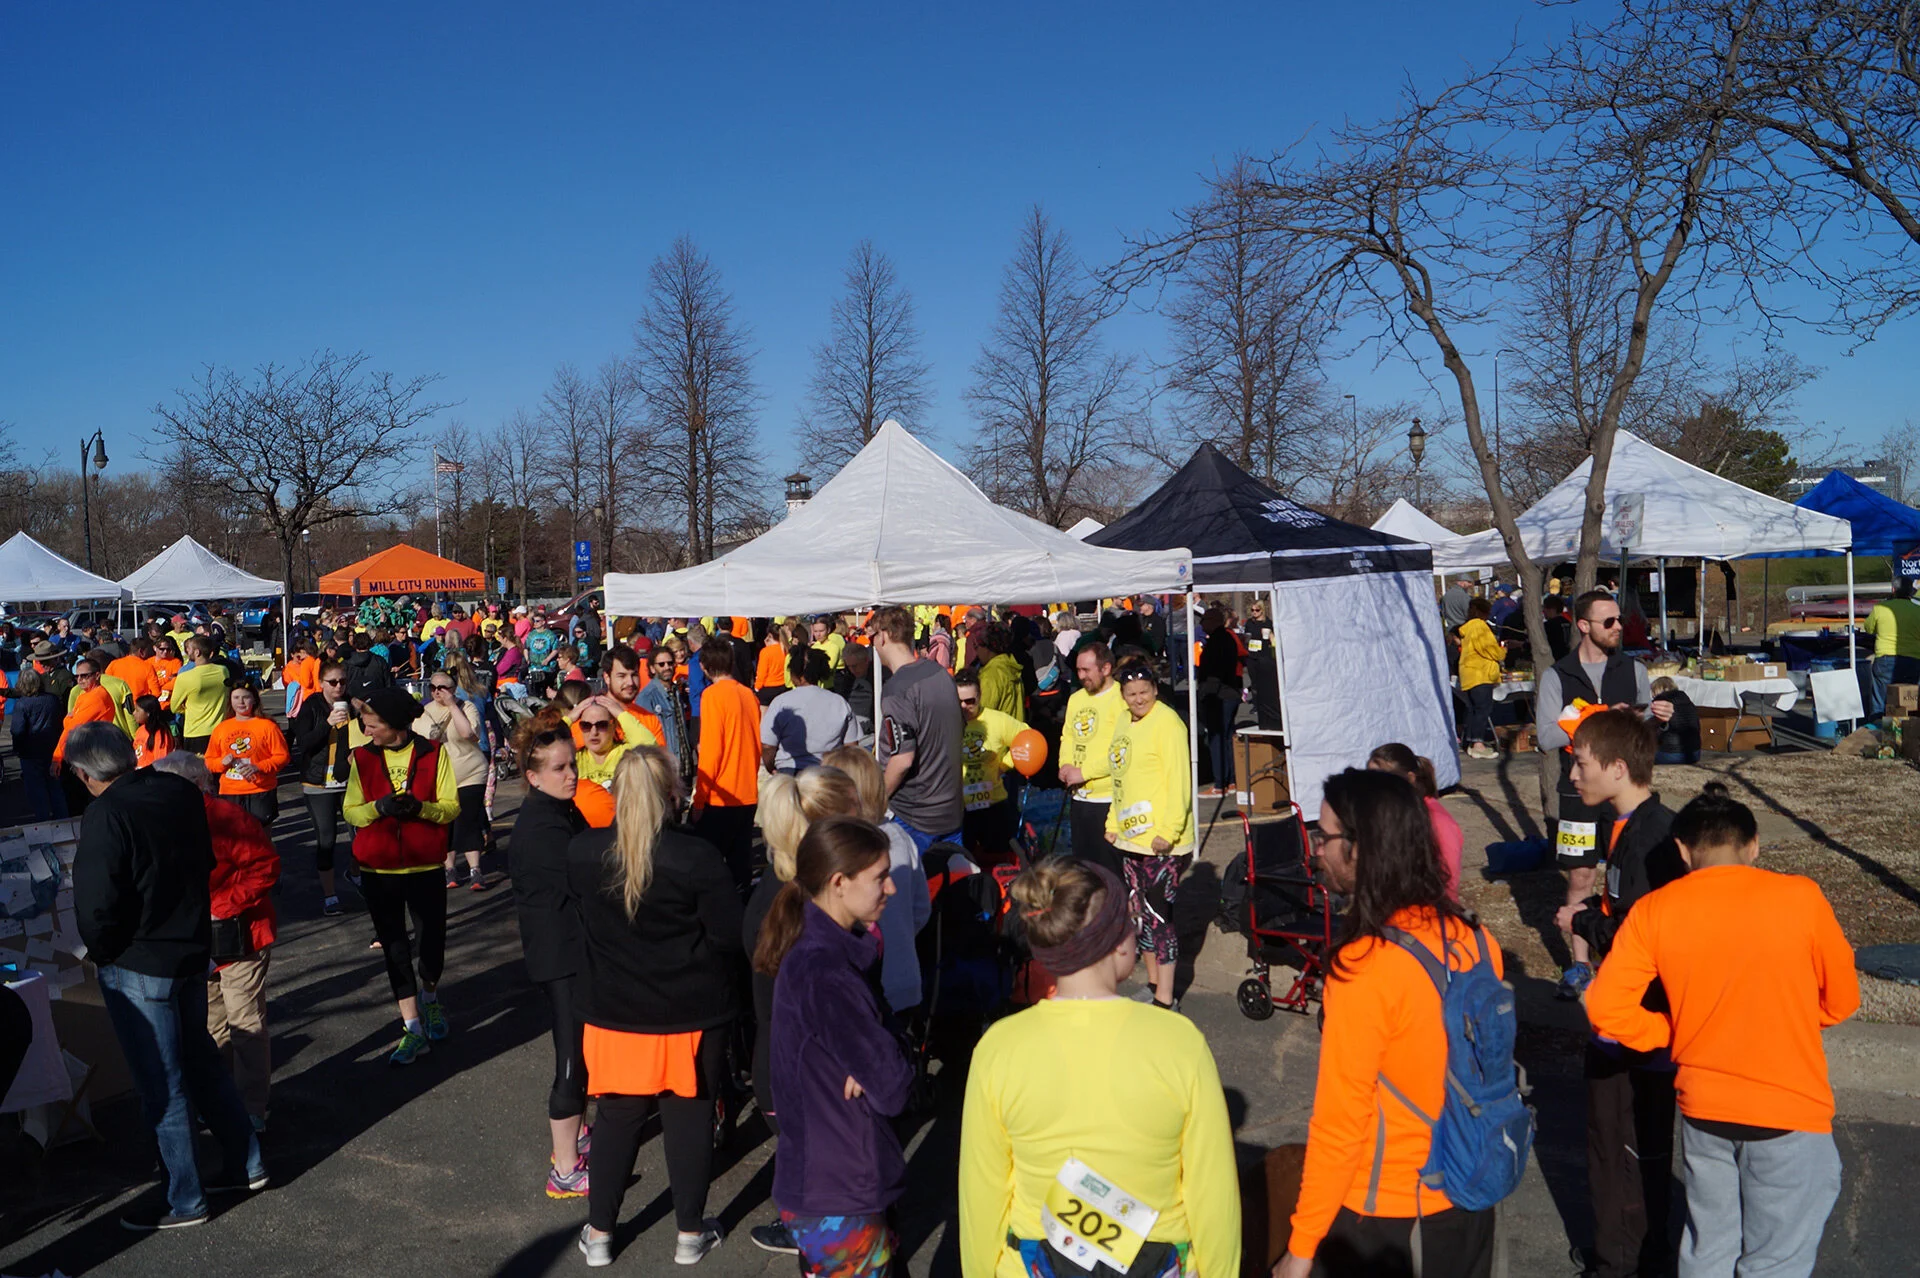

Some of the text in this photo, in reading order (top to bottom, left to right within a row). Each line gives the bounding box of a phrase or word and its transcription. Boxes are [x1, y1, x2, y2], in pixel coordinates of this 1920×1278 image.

[369, 578, 476, 592] MILL CITY RUNNING
[971, 791, 990, 802] 700
[1124, 814, 1147, 829] 690
[1562, 833, 1586, 845] 634
[1057, 1199, 1122, 1252] 202
